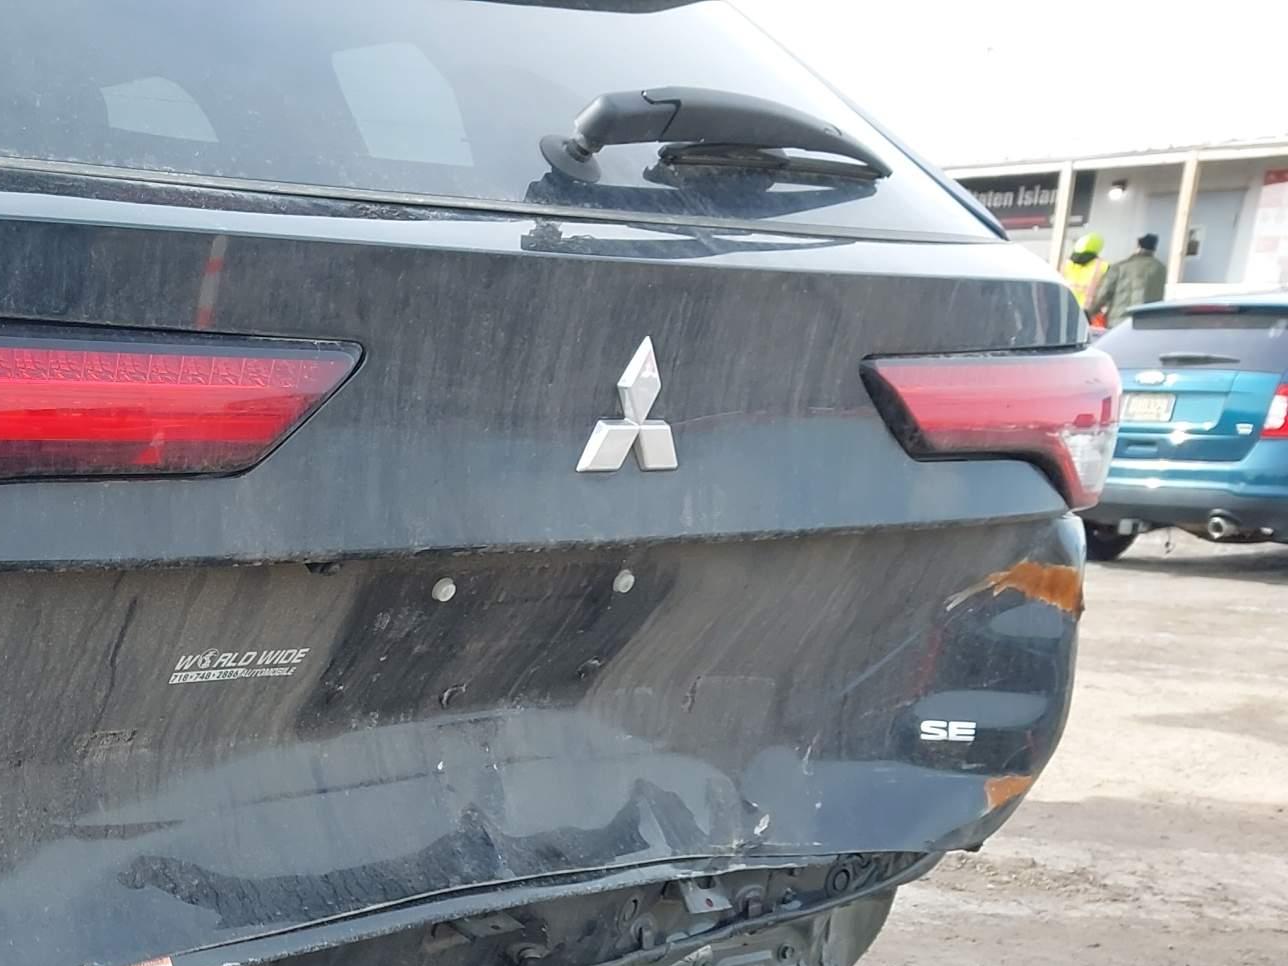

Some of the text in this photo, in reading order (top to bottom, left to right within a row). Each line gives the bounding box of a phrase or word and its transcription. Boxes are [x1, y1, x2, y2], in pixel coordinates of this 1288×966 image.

[1017, 185, 1059, 207] Islan
[257, 648, 310, 665] WIDE
[919, 719, 977, 742] SE
